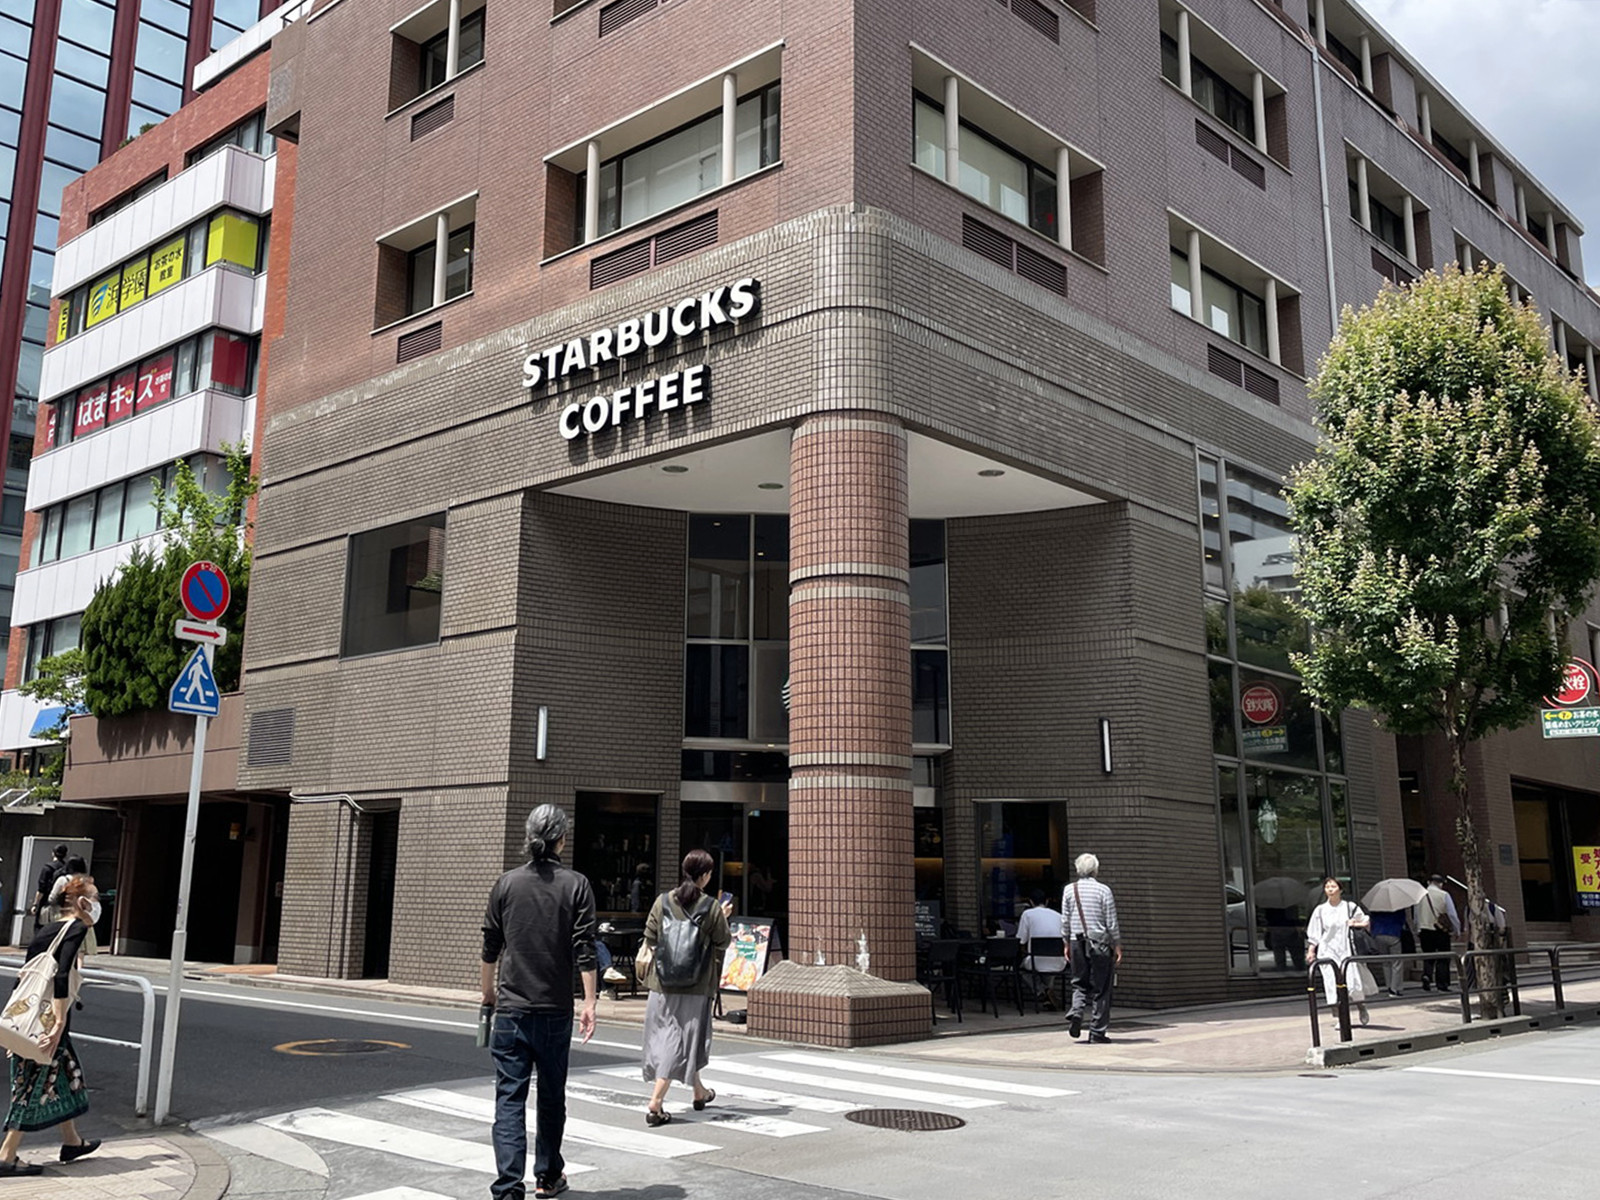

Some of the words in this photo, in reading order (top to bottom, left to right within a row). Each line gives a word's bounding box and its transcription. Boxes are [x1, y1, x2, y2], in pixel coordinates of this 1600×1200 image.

[522, 278, 756, 388] STARBUCKS
[77, 368, 157, 427] はまキッズ
[559, 364, 705, 440] COFFEE
